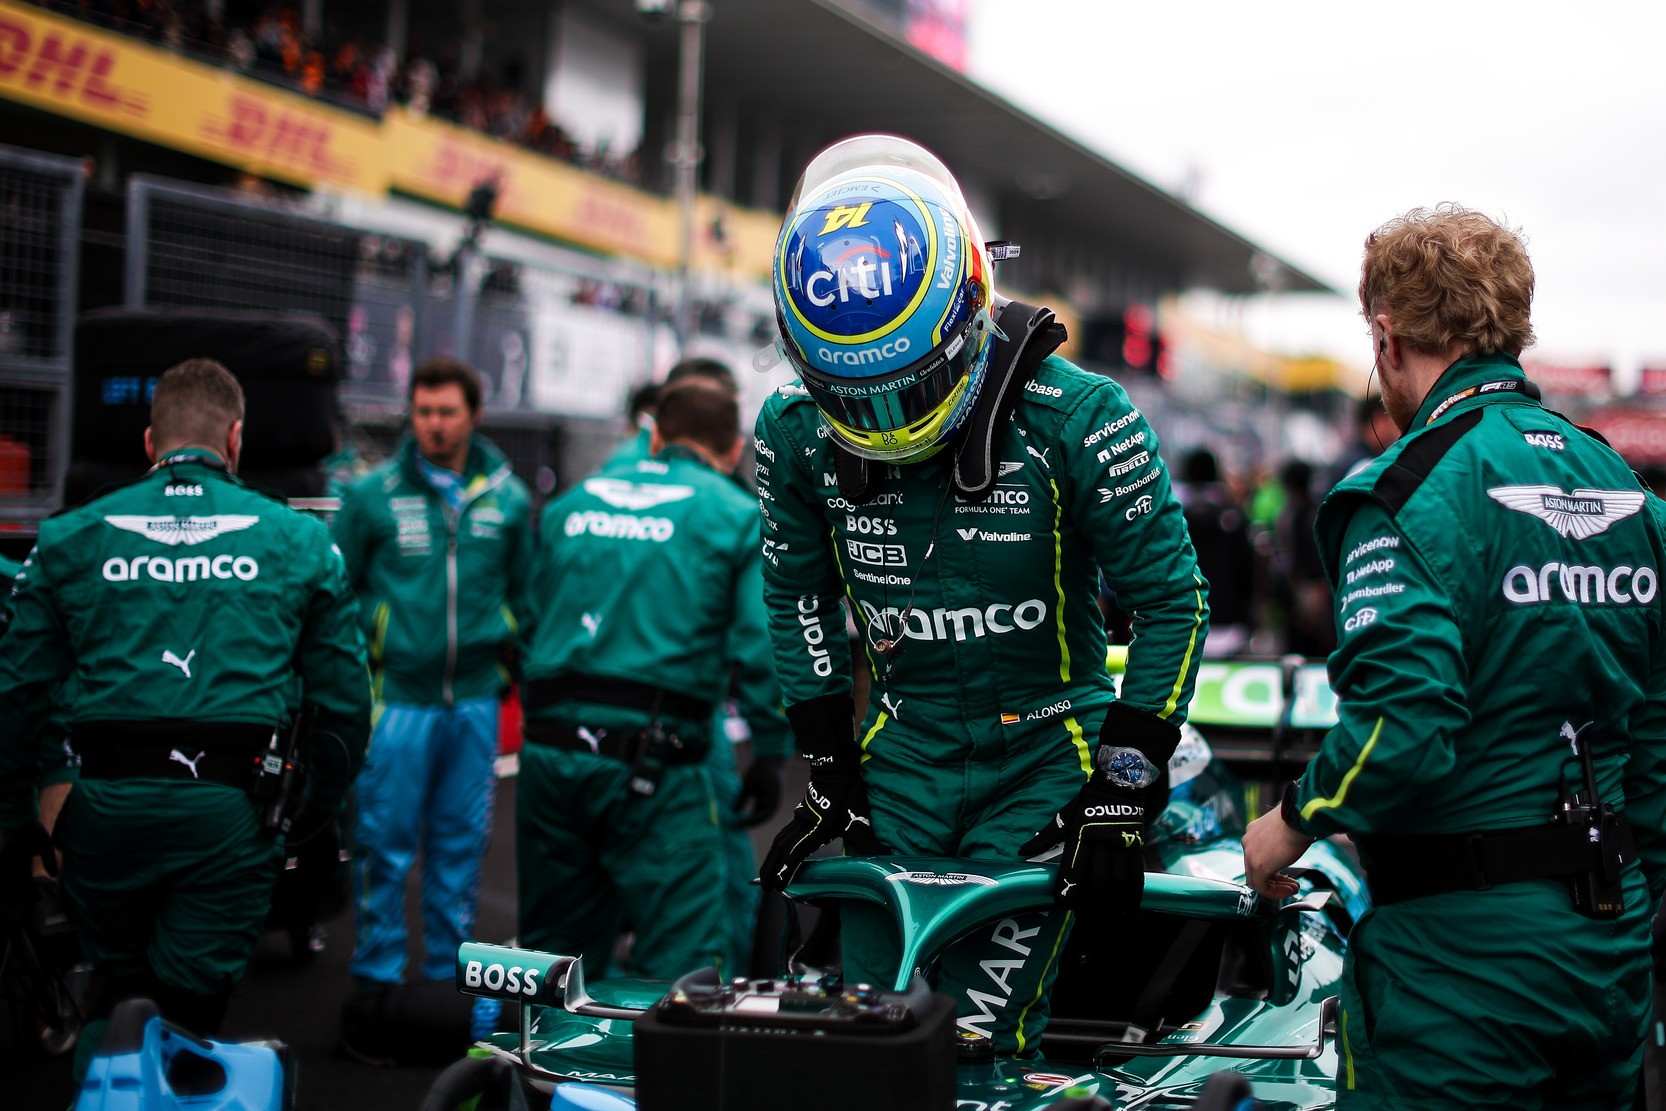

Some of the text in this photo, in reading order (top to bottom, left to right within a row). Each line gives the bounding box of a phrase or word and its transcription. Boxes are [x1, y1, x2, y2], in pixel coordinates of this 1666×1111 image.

[816, 202, 874, 237] 14
[936, 206, 958, 290] Valvoline
[806, 255, 893, 308] citi
[818, 337, 911, 366] aramco
[830, 384, 867, 396] ASTON
[868, 374, 916, 396] MARTIN
[1083, 408, 1140, 448] servicenow
[1110, 430, 1145, 456] NetApp
[1523, 433, 1565, 450] BOSS
[1108, 450, 1150, 478] PIRELLI
[164, 484, 204, 497] BOSS
[955, 506, 988, 514] FORMULA
[1009, 506, 1031, 515] TEAM
[1125, 496, 1153, 521] citi
[1544, 497, 1602, 513] ASTON MARTIN
[564, 511, 675, 543] aramco
[845, 514, 898, 536] BOSS
[978, 531, 1033, 542] Valvoline
[847, 540, 906, 565] JCB
[102, 554, 259, 584] aramco
[853, 568, 912, 586] SentinelOne
[1502, 562, 1657, 604] aramco
[860, 598, 1047, 642] aramco
[1344, 607, 1378, 631] citi
[1026, 699, 1072, 721] ALONSO
[1084, 804, 1145, 817] aramco
[465, 960, 540, 997] BOSS
[957, 912, 1049, 1039] MAR
